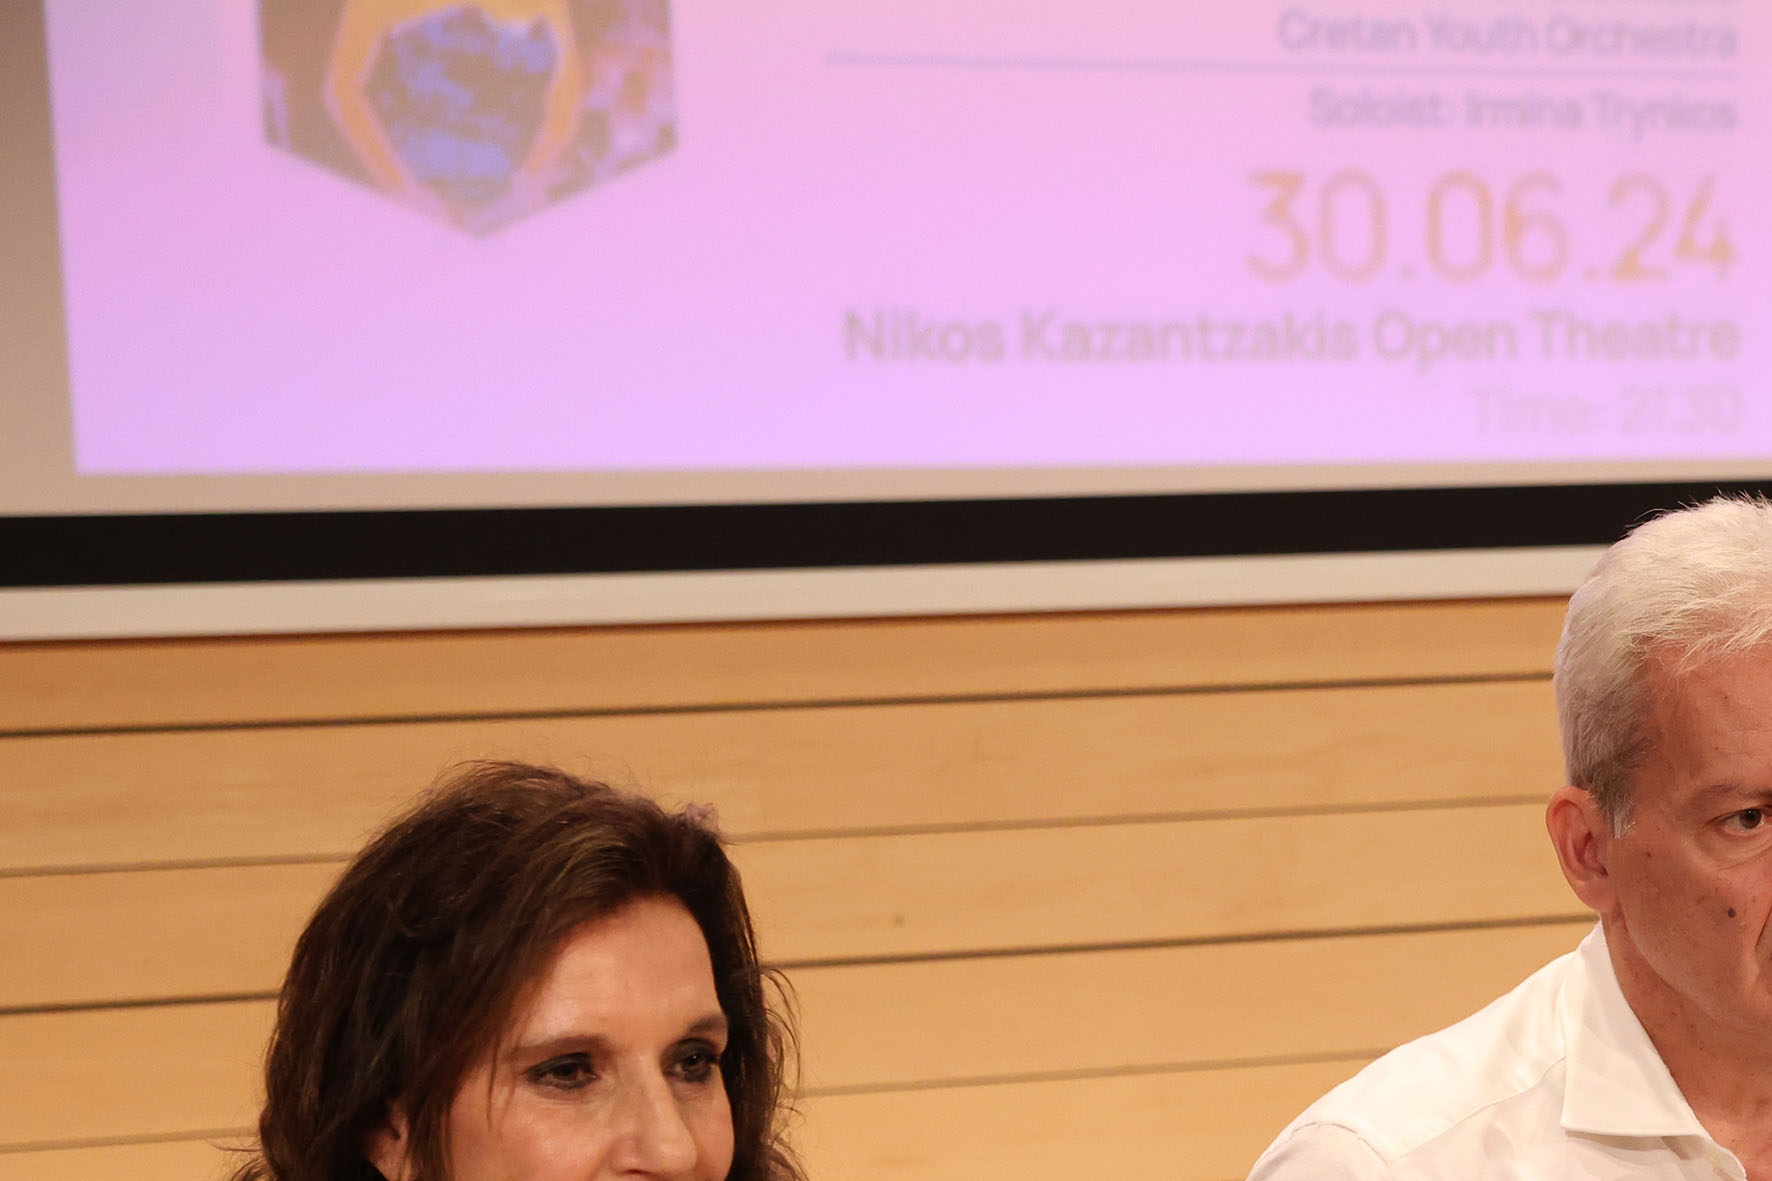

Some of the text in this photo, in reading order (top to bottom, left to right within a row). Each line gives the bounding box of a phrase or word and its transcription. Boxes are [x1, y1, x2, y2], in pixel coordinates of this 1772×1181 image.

[1276, 9, 1738, 60] Cretan Youth Orchestra
[1308, 88, 1738, 142] Soloist: Irmina Trynkos
[1243, 168, 1738, 286] 30.06.24
[843, 309, 1742, 375] Nikos Kazantzakis Open Theatre
